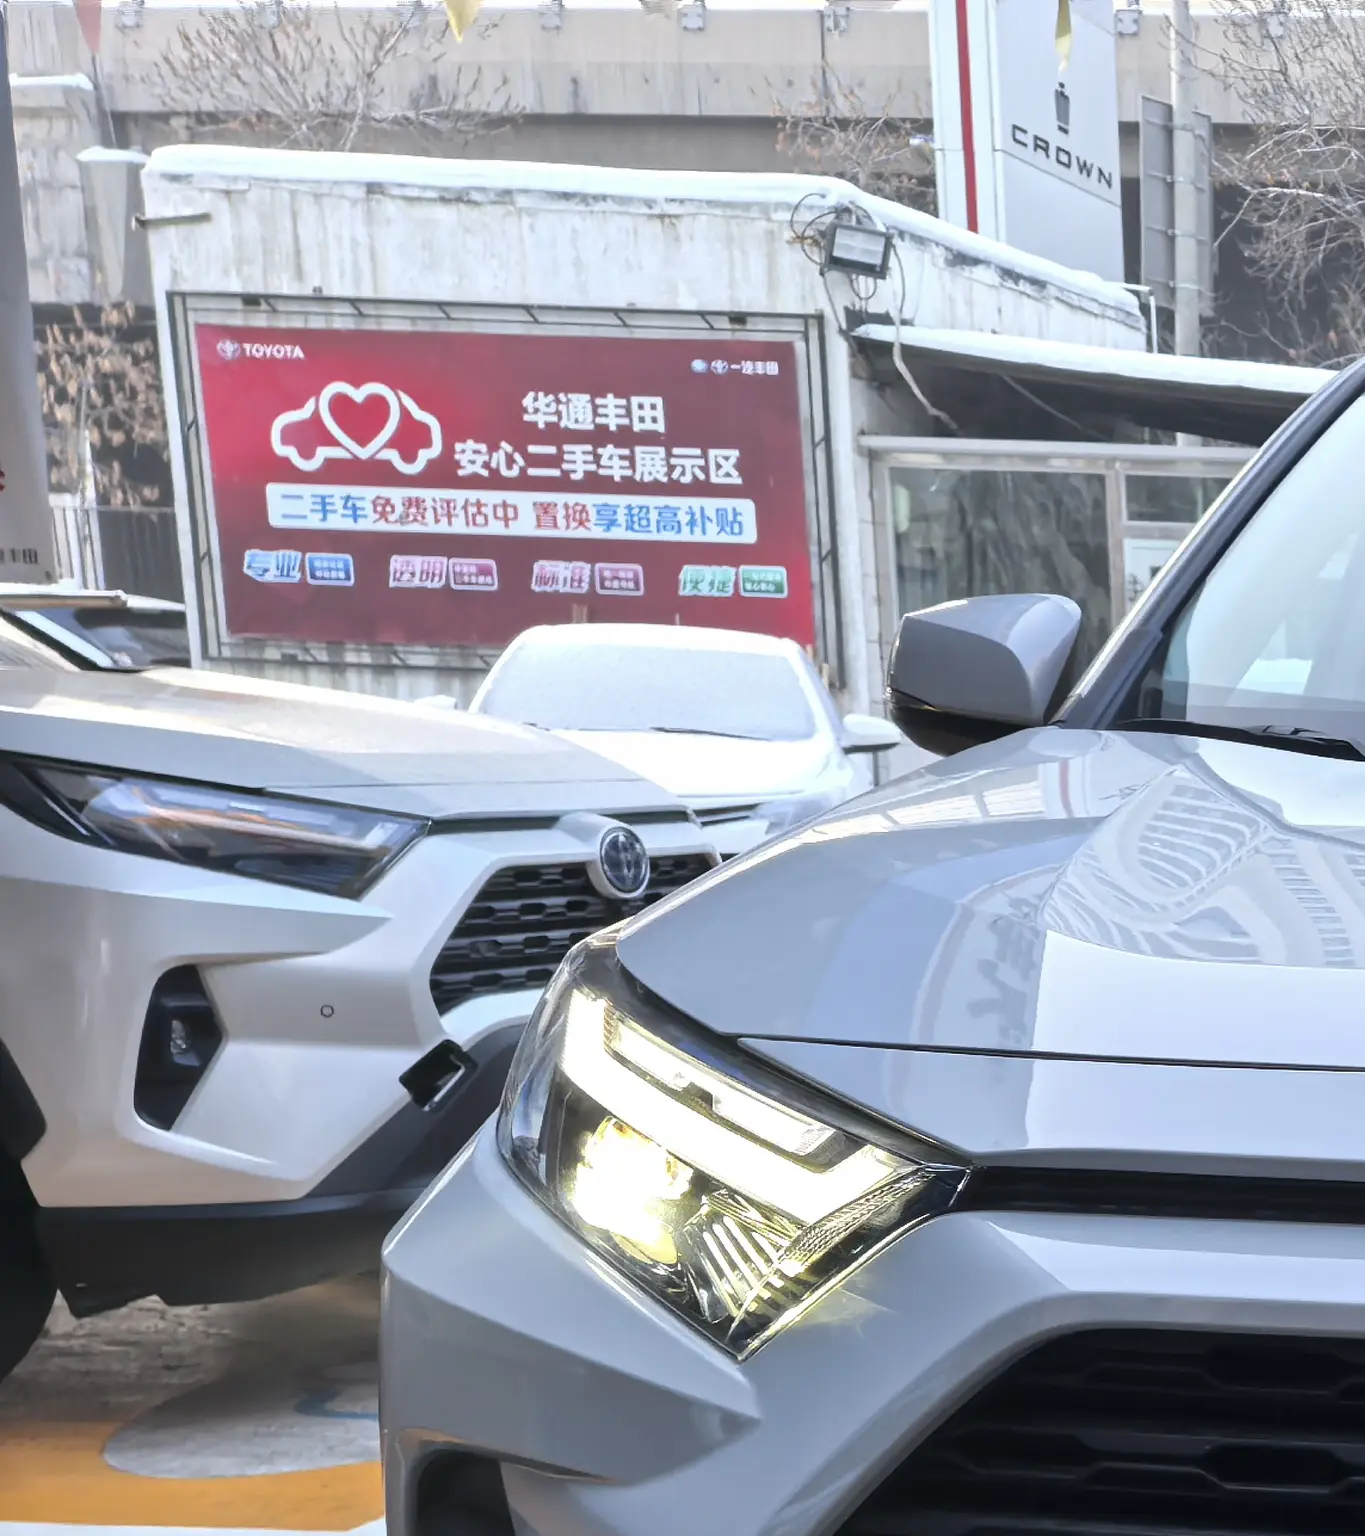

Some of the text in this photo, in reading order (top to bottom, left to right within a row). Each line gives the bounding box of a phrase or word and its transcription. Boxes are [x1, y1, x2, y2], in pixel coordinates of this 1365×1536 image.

[1011, 123, 1113, 190] CROWN
[242, 342, 305, 359] TOYOTA
[521, 391, 667, 433] 华通丰田
[453, 438, 743, 485] 安心二手车展示区
[280, 491, 744, 537] 二手车免费评估中 置换享超高补贴
